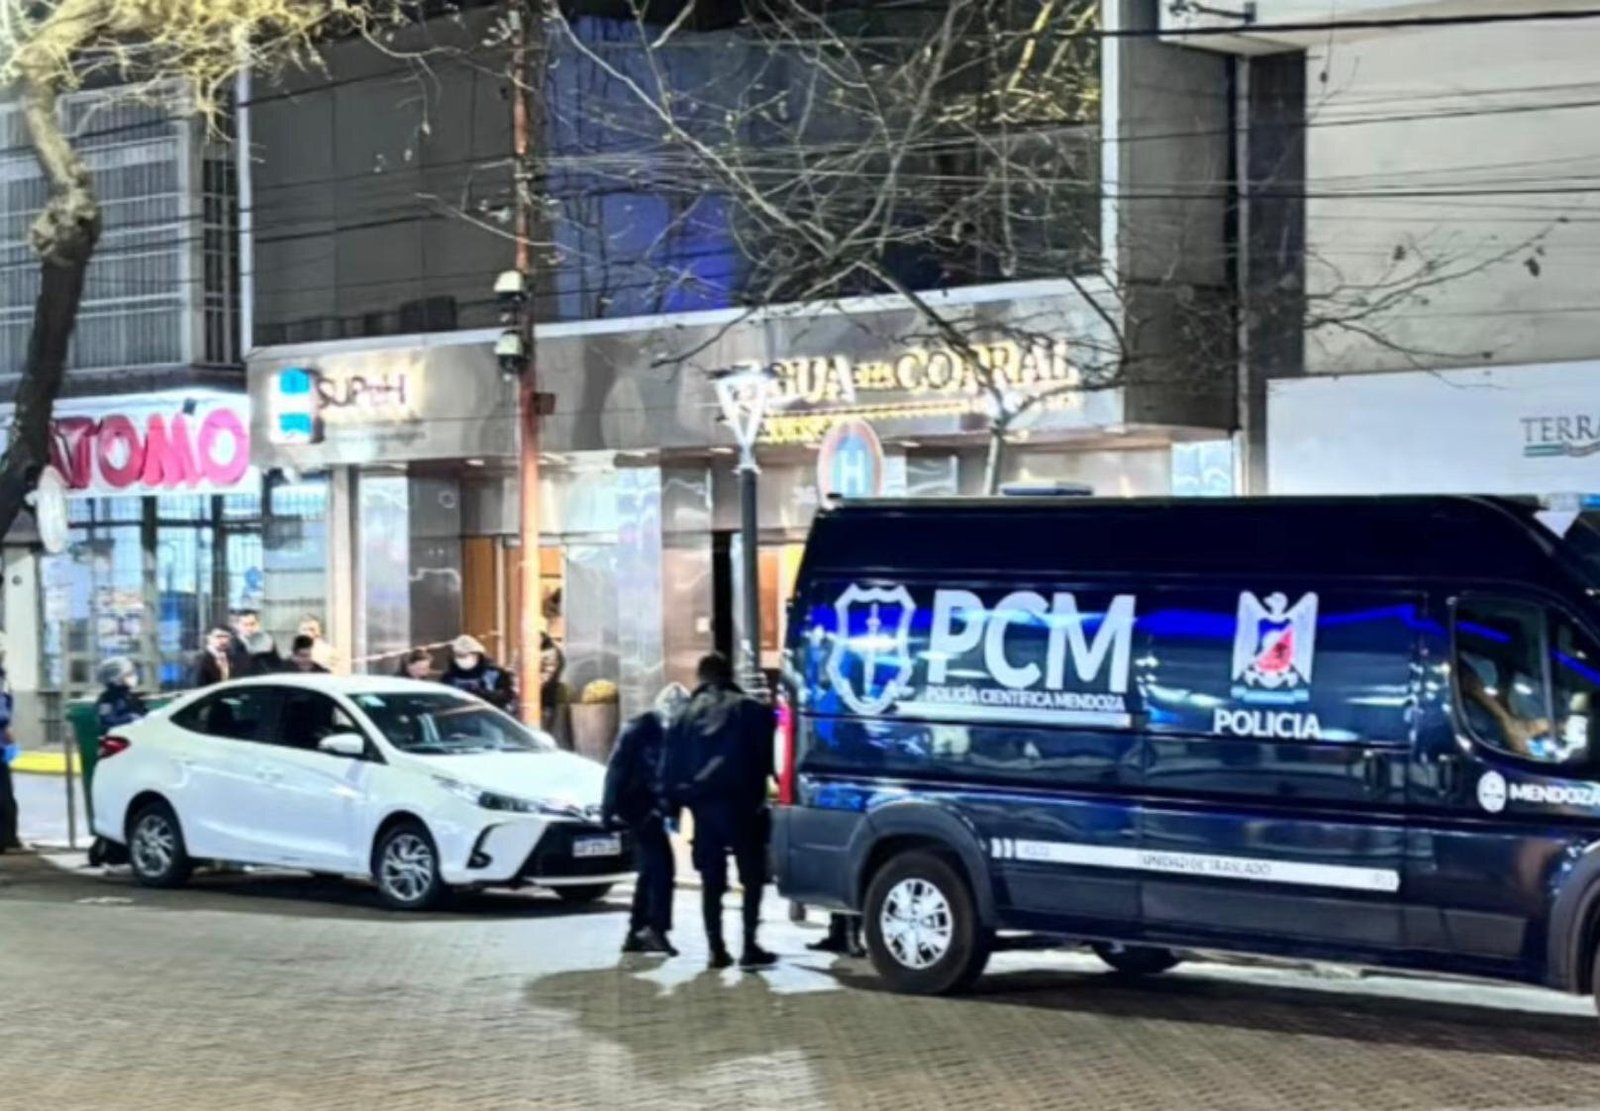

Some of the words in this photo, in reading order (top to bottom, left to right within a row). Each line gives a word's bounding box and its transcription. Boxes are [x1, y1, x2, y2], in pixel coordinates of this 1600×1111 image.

[1519, 414, 1600, 442] TERR
[927, 589, 1137, 693] PCM
[1055, 692, 1127, 713] MENDOZA
[1212, 707, 1322, 739] POLICIA
